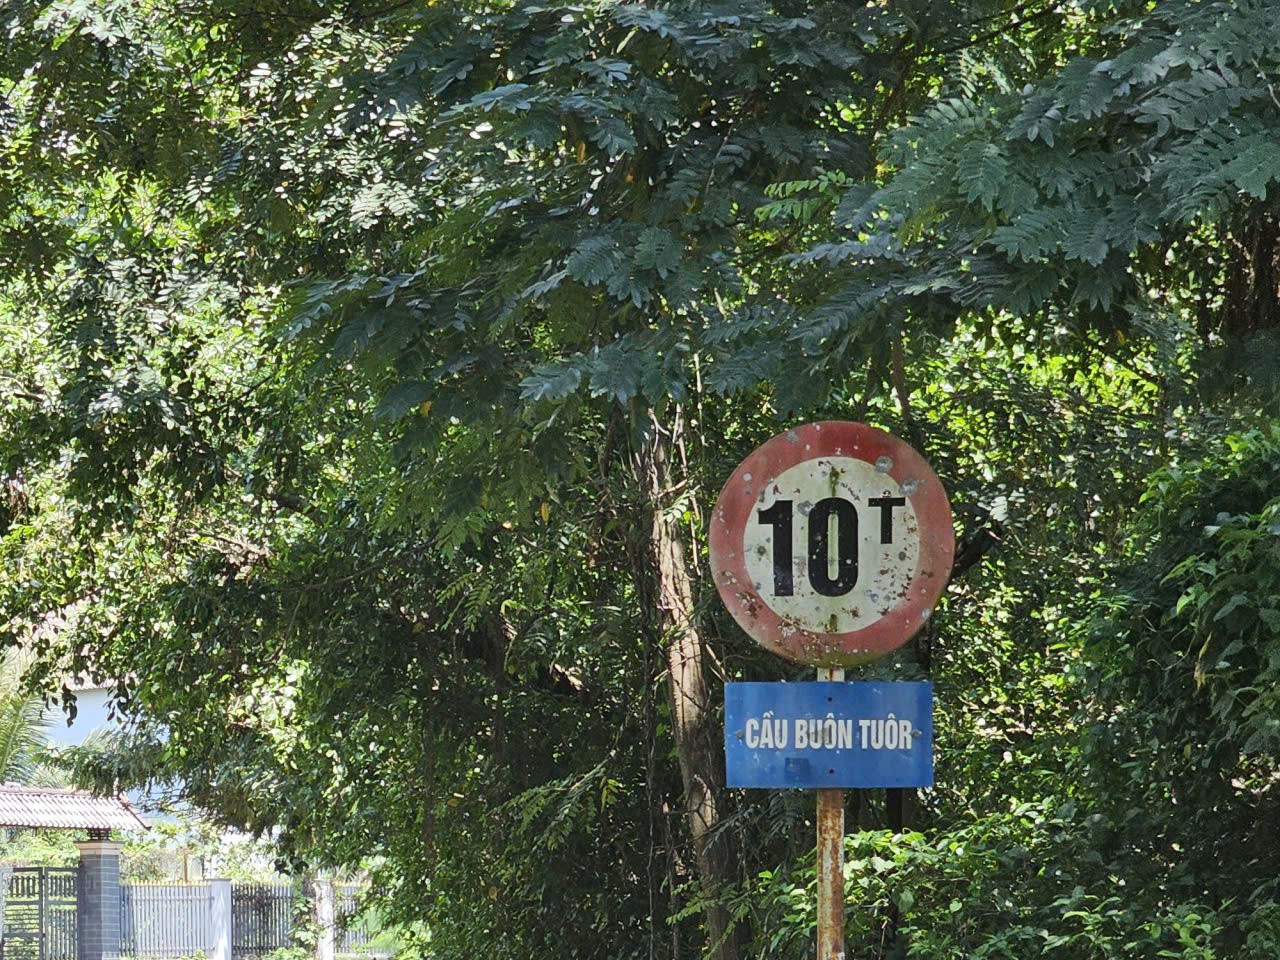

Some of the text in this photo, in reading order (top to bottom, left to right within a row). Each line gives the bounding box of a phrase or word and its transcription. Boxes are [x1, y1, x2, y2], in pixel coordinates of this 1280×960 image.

[745, 710, 913, 751] CẦU BUÔN TUÔR
